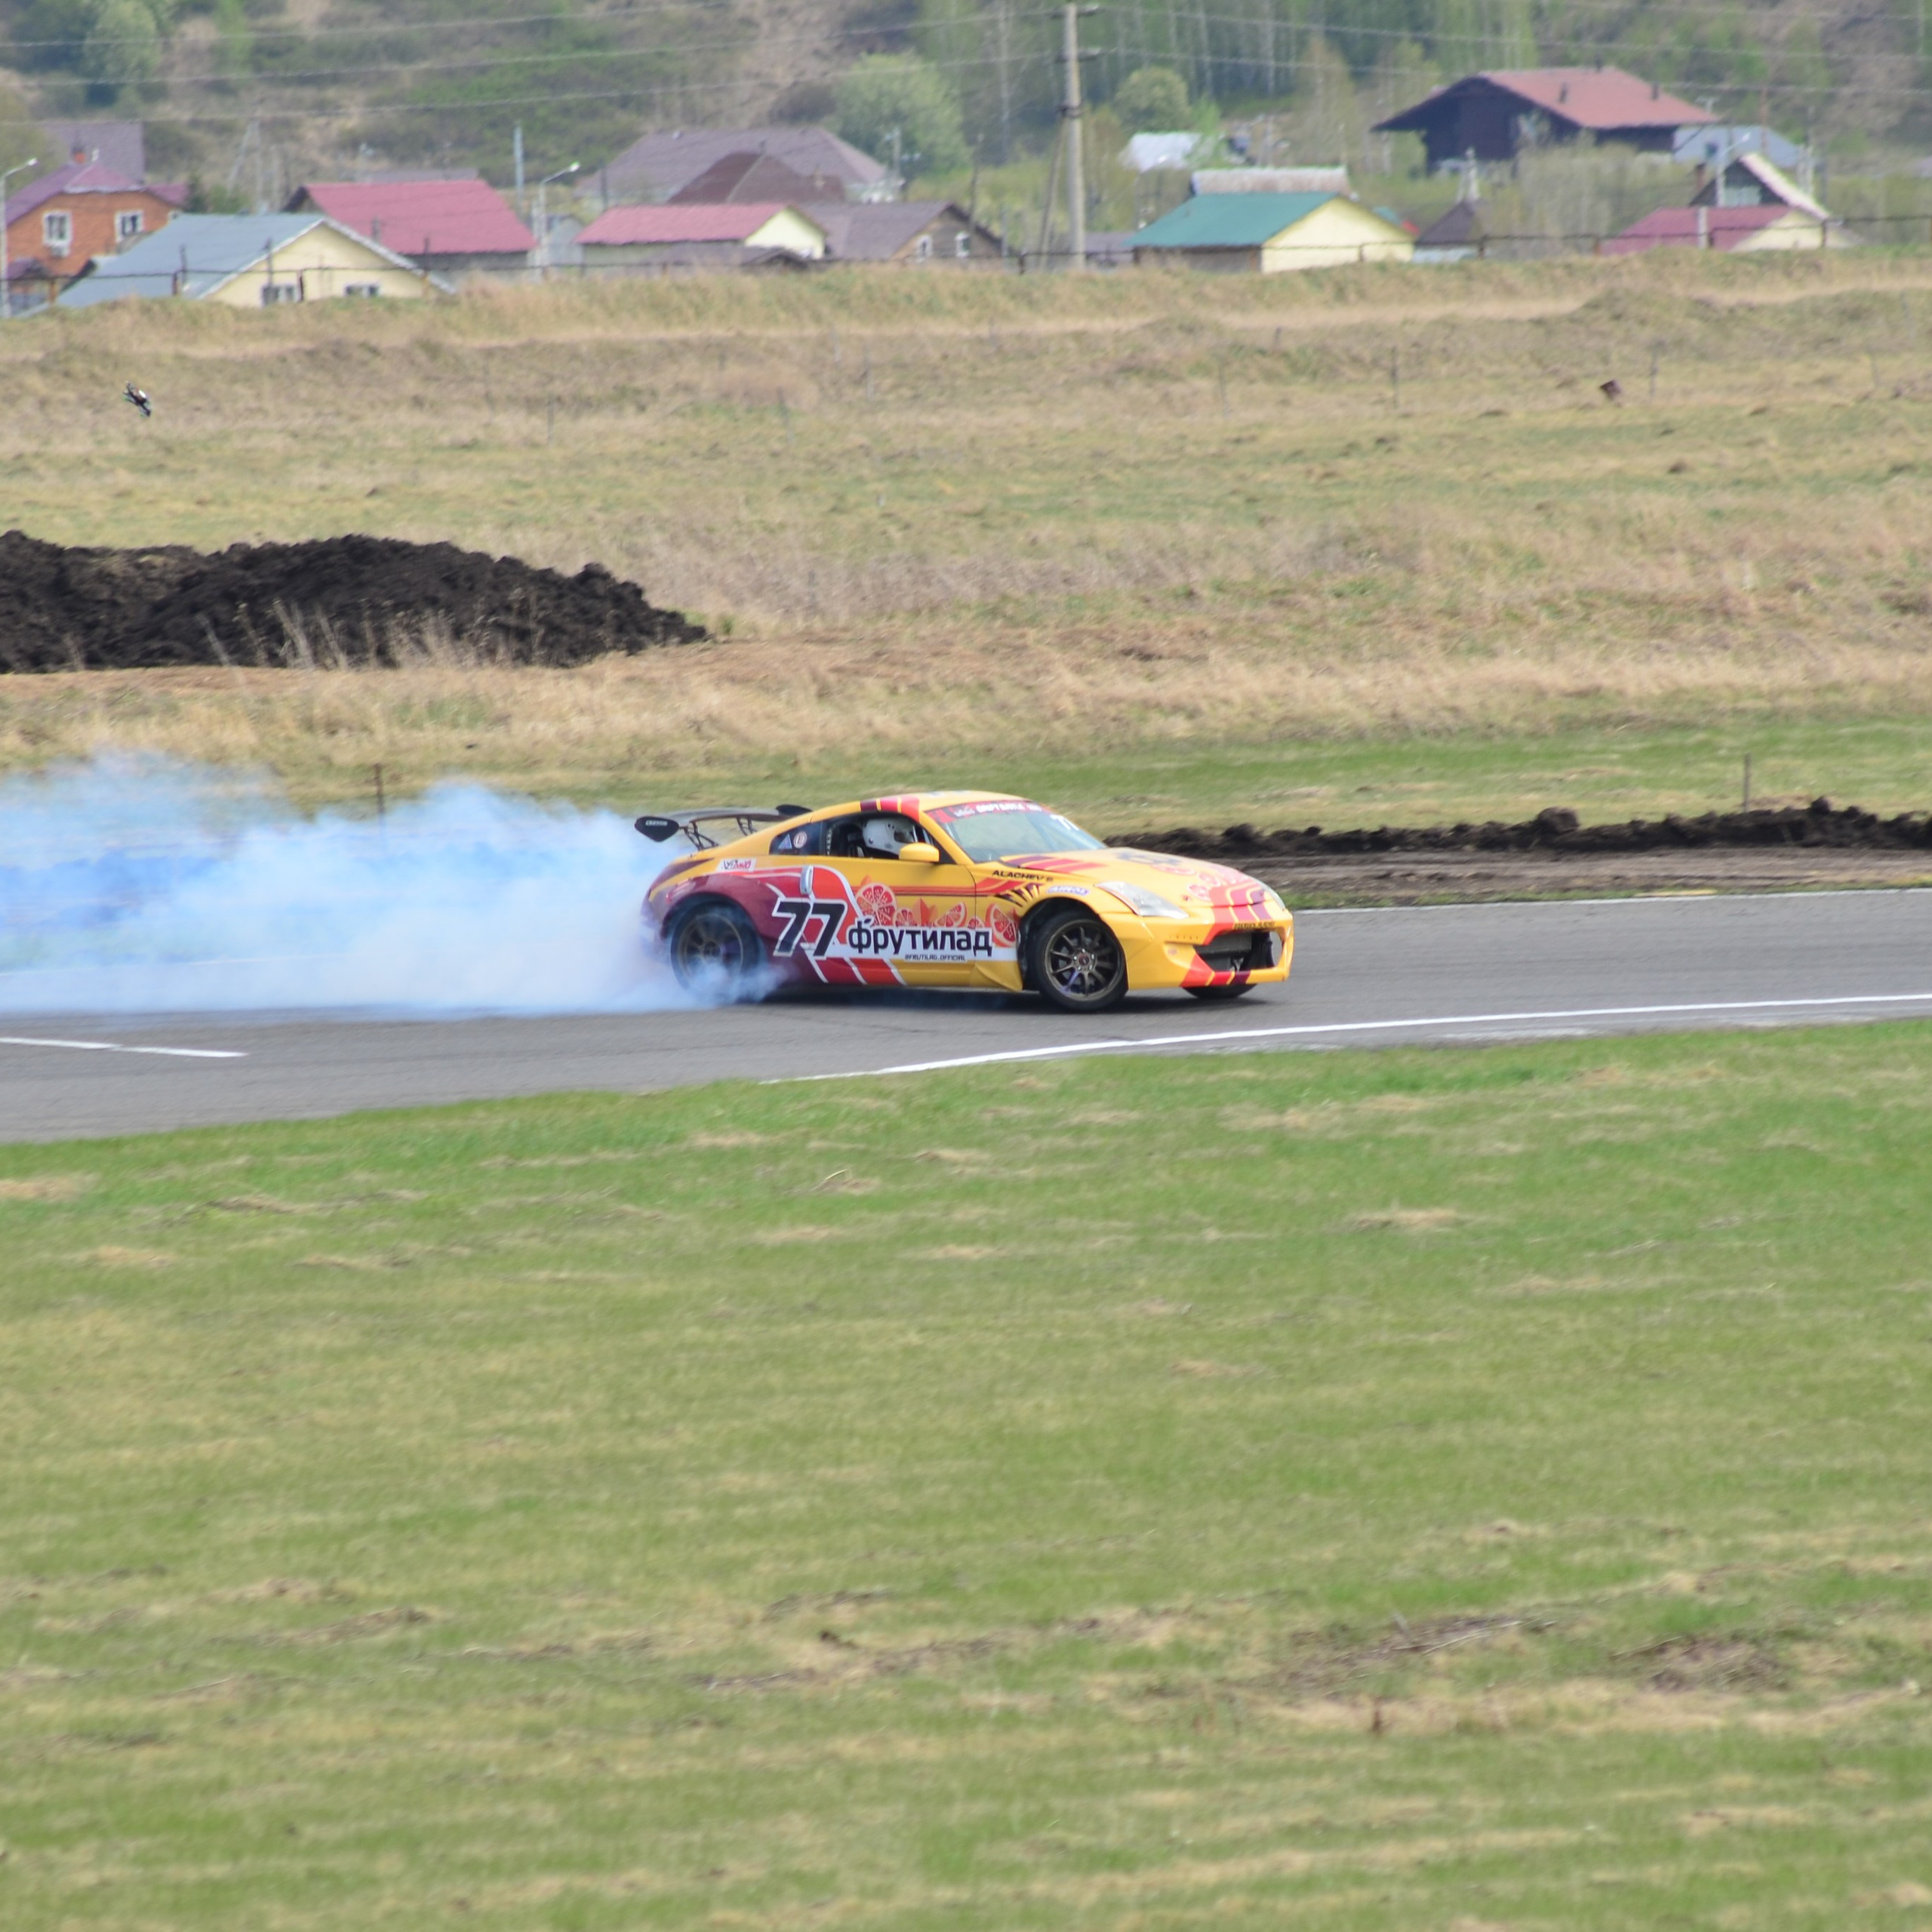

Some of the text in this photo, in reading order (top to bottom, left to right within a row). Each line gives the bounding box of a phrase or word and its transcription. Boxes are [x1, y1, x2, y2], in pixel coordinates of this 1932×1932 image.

[992, 870, 1044, 880] ALACHEV
[774, 898, 847, 959] 77
[848, 920, 992, 957] фрутилад
